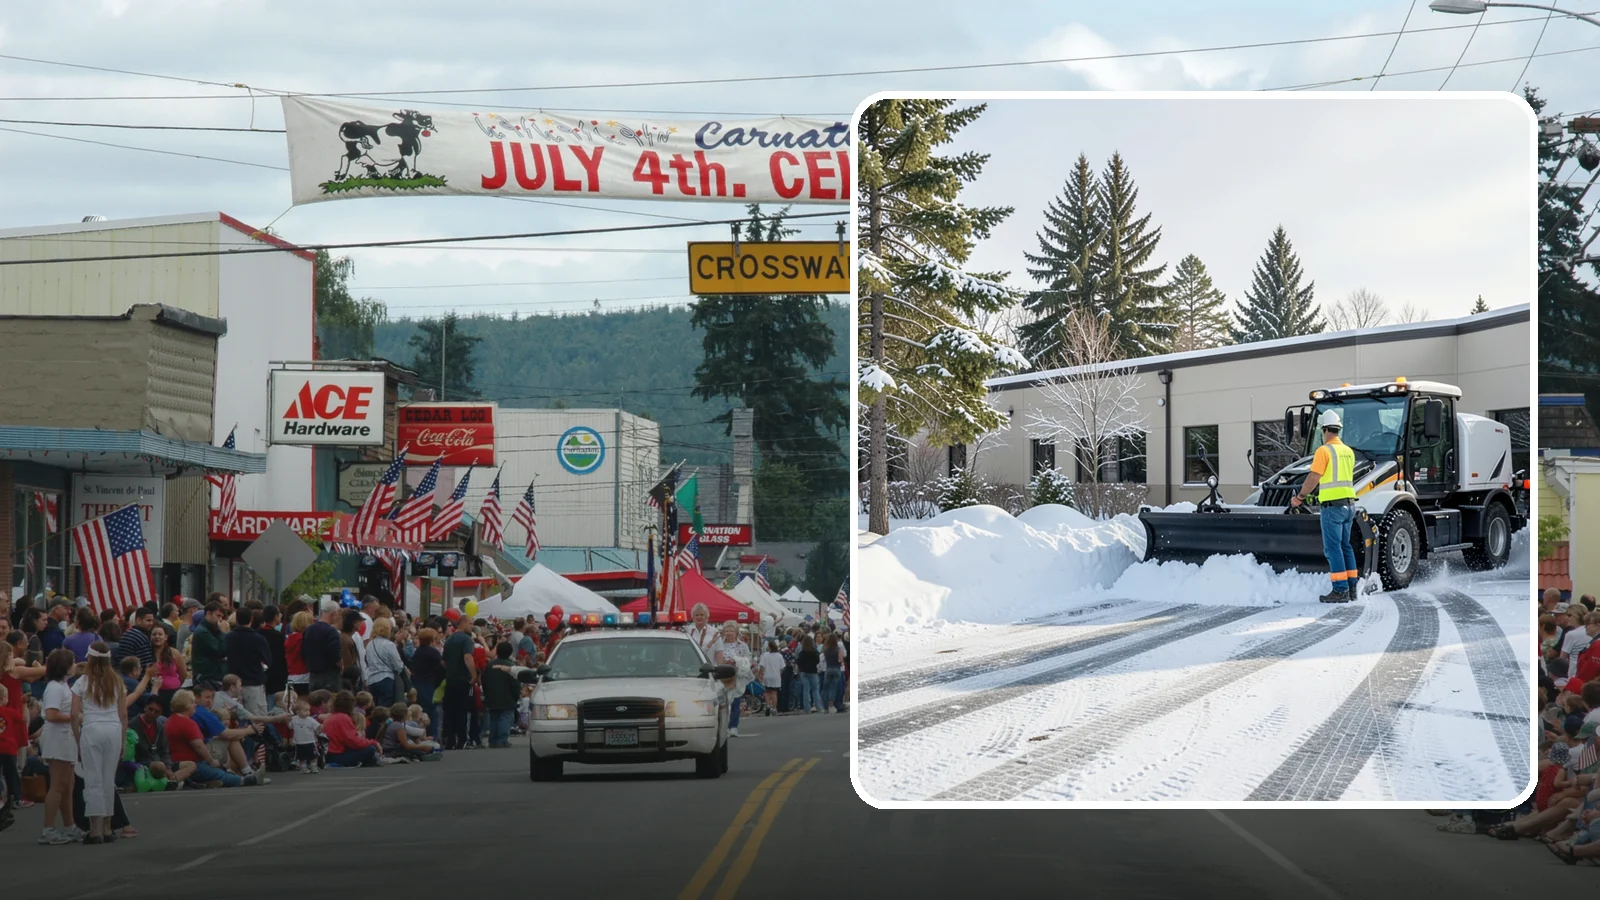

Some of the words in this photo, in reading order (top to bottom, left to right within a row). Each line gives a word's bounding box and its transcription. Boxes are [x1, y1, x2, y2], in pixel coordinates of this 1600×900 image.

[695, 121, 850, 150] Carnat
[481, 141, 605, 192] JULY
[632, 150, 746, 197] 4th.
[697, 254, 850, 280] CROSSWA
[283, 380, 373, 420] ACE
[405, 409, 452, 422] CEDAR
[284, 421, 370, 436] Hardware
[416, 428, 477, 447] Coca-Cola
[83, 486, 93, 494] St.
[96, 485, 125, 495] Vincent
[126, 486, 136, 495] de
[138, 486, 155, 496] Paul
[688, 526, 741, 535] CRNATION
[699, 535, 730, 543] GLASS
